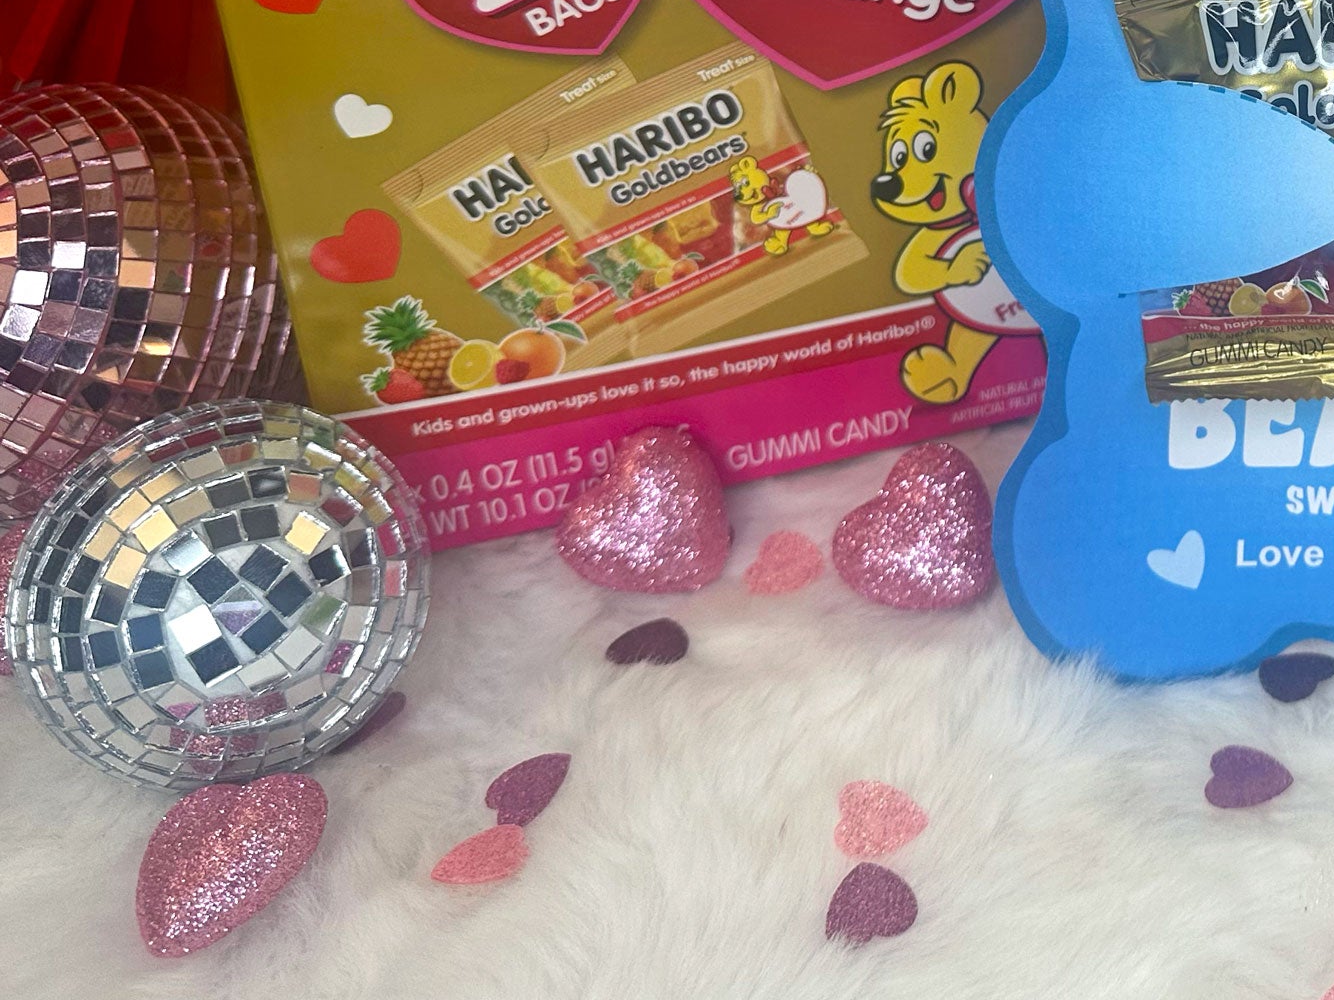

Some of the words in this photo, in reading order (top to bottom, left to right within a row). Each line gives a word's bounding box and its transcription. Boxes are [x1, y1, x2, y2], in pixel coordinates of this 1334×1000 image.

[560, 77, 599, 103] Treat
[697, 59, 735, 83] Treat
[575, 91, 742, 185] HARIBO
[609, 134, 748, 205] Goldbears
[1190, 340, 1260, 367] GUMMI
[1263, 337, 1328, 358] CANDY
[412, 417, 454, 437] Kids
[457, 408, 494, 429] and
[499, 390, 598, 423] grown-ups
[601, 379, 639, 400] love
[642, 375, 656, 392] it
[659, 373, 686, 389] so,
[689, 366, 719, 382] the
[723, 354, 779, 376] happy
[782, 338, 833, 363] world
[836, 334, 854, 351] of
[727, 426, 822, 472] GUMMI
[827, 405, 914, 448] CANDY
[430, 468, 475, 501] 0.4
[480, 459, 524, 490] OZ
[429, 504, 470, 537] WT
[477, 493, 527, 526] 10.1
[530, 482, 572, 513] OZ
[1235, 539, 1325, 568] Love
